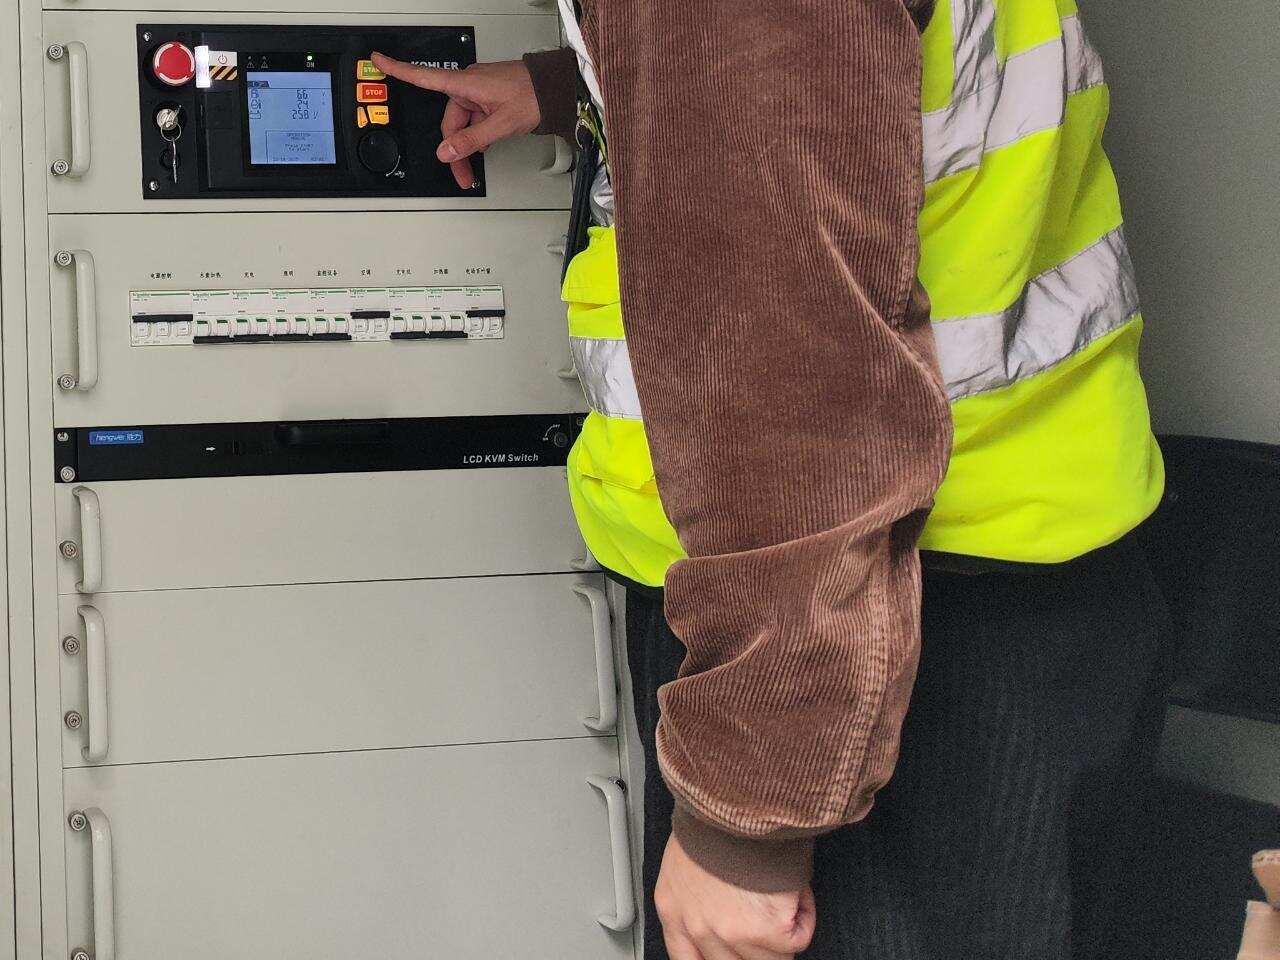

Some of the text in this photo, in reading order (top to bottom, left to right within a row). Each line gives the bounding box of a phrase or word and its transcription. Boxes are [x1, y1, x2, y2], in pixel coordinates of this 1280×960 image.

[365, 88, 384, 96] STOP
[463, 452, 539, 464] LCD KVM Switch
